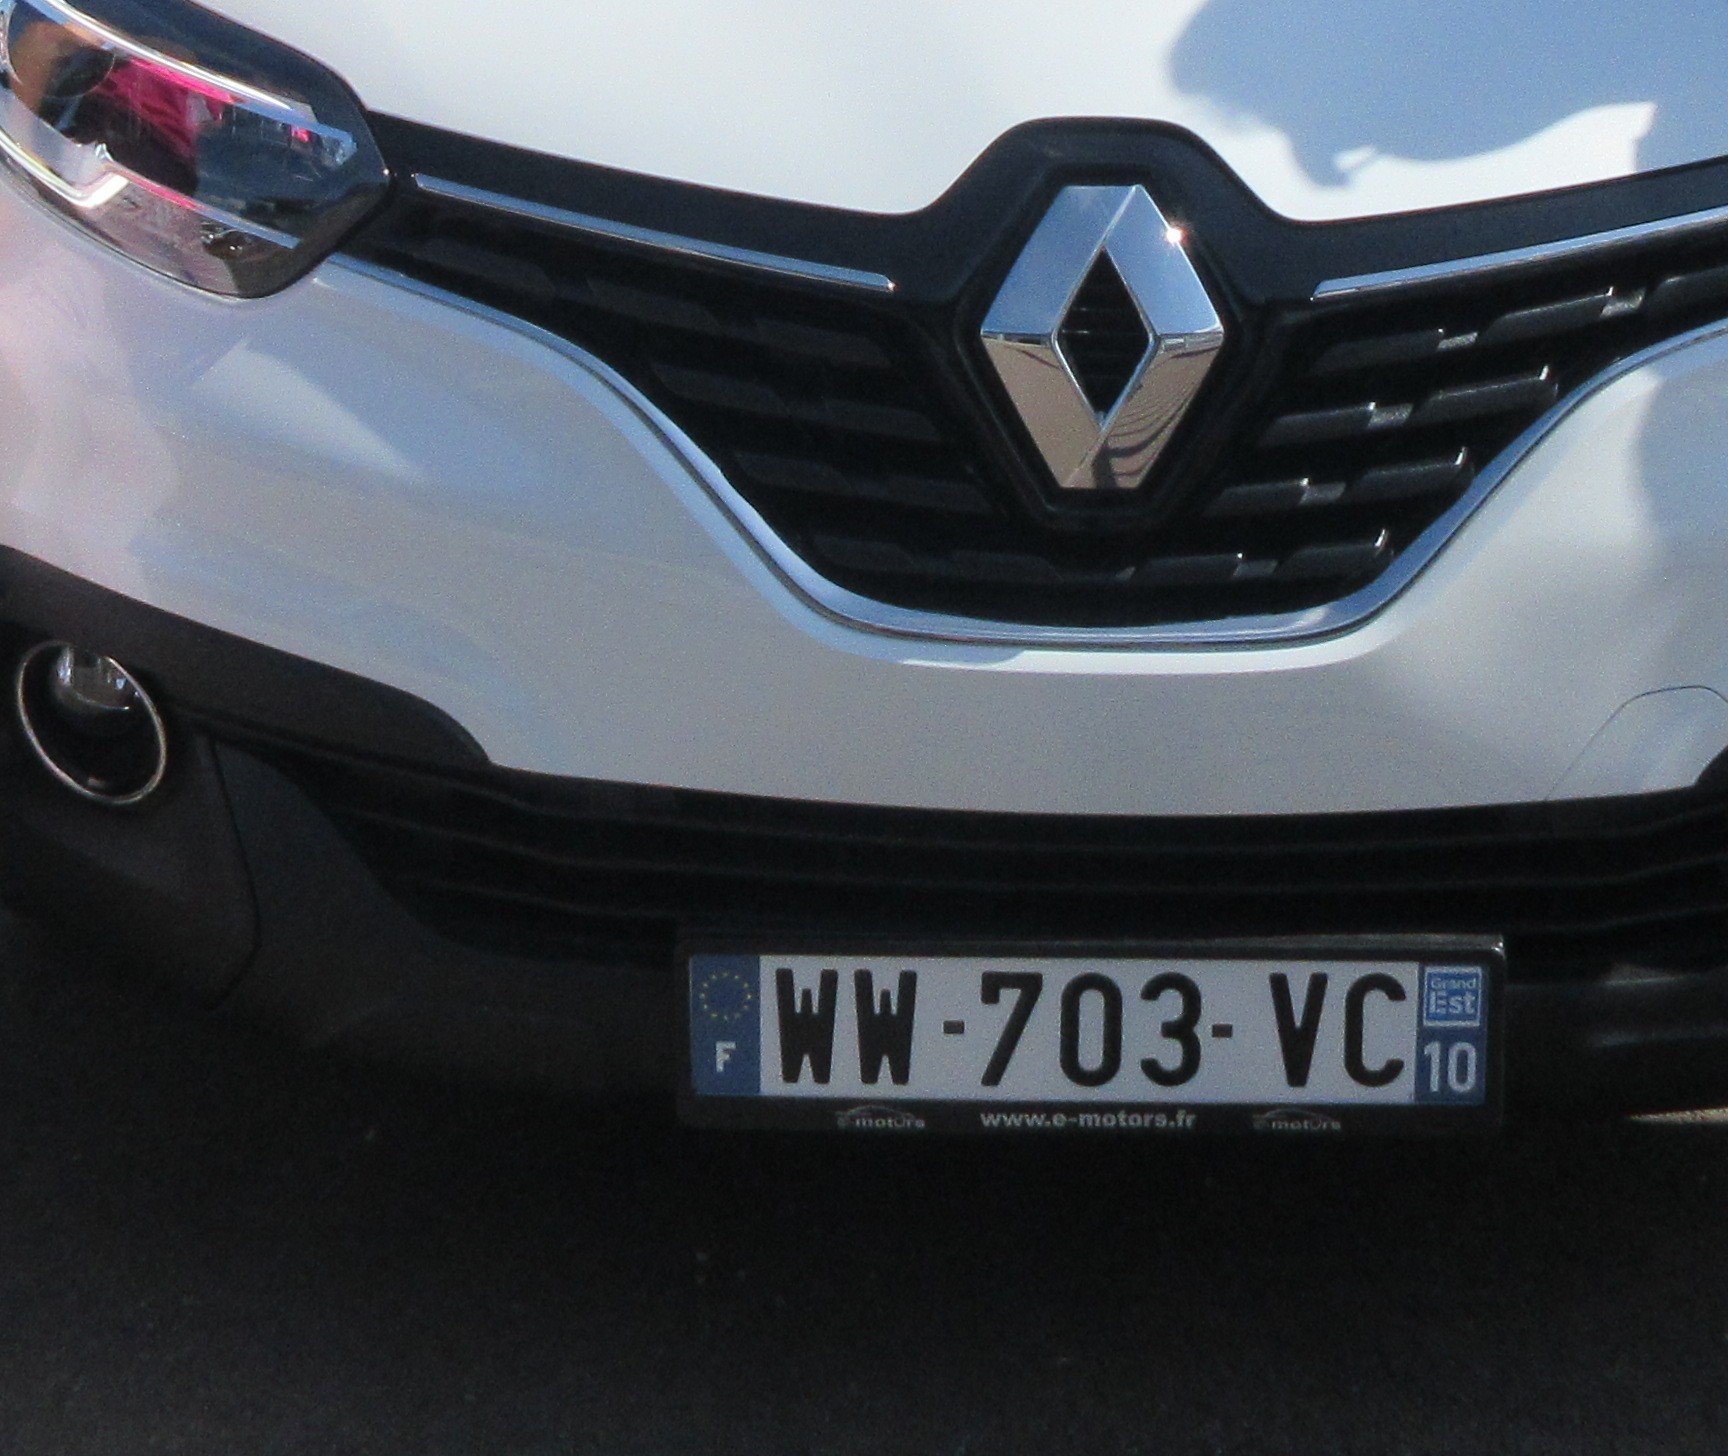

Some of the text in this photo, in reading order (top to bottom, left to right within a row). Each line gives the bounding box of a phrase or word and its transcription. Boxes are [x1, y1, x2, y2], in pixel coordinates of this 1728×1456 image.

[1430, 977, 1478, 991] Grand
[1429, 990, 1477, 1015] Est
[715, 1041, 736, 1073] F
[1423, 1041, 1477, 1093] 10
[979, 1108, 1197, 1129] www.e-motors.fr
